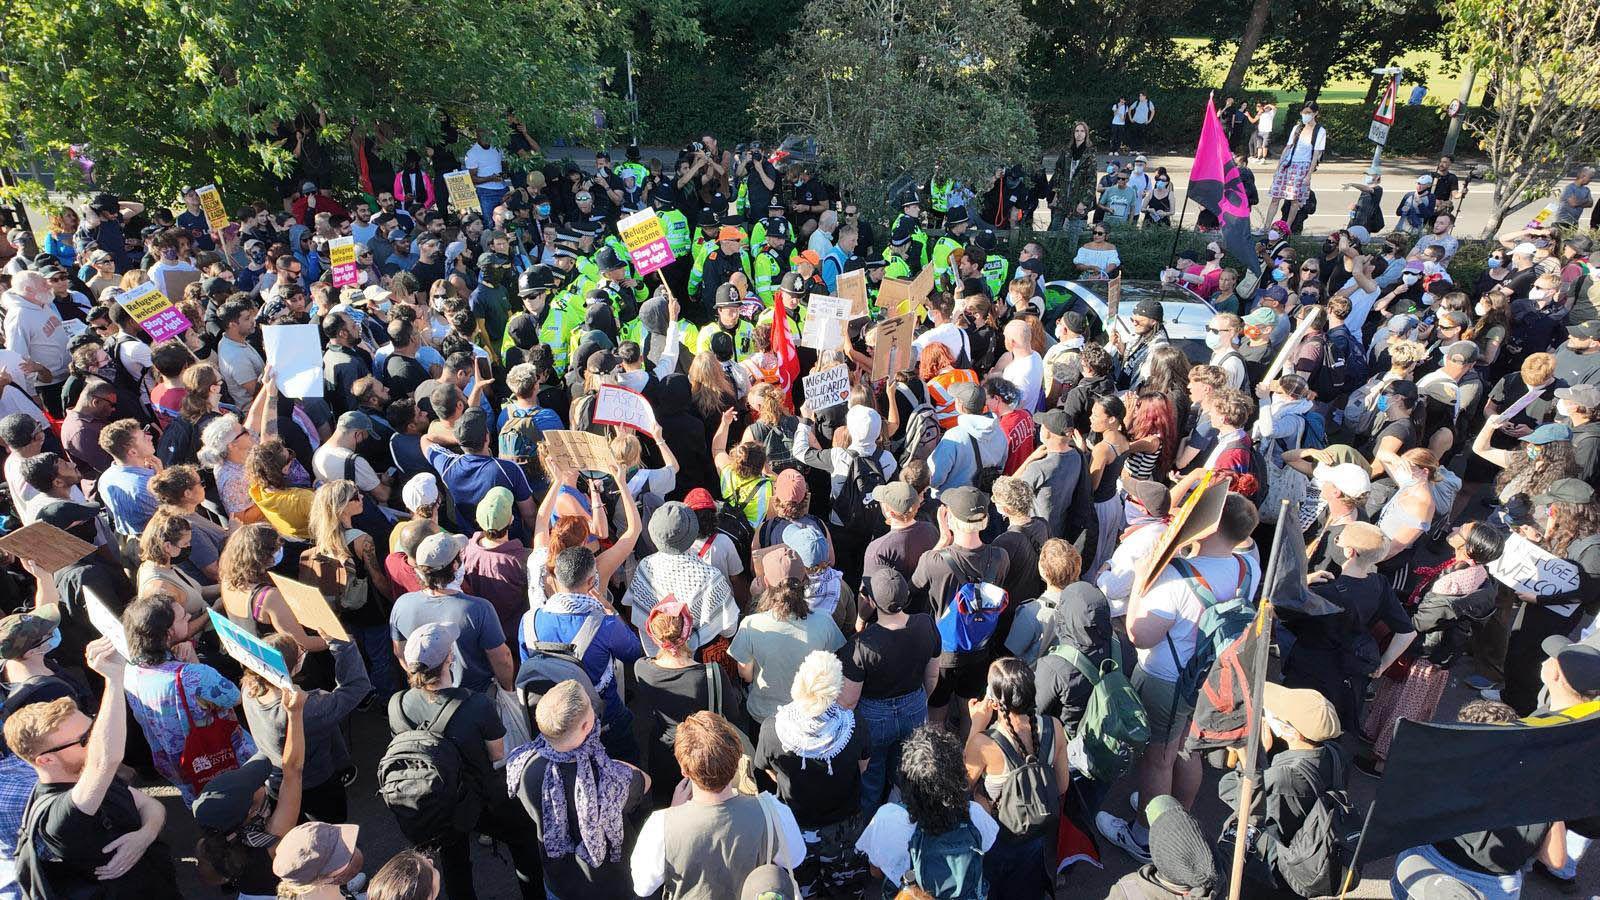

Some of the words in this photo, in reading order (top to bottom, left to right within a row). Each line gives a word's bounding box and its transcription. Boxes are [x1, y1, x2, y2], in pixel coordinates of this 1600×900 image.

[623, 220, 658, 240] Refugees
[628, 230, 661, 248] welcome
[632, 248, 652, 261] Stop
[650, 242, 665, 253] the
[637, 260, 649, 270] far
[649, 250, 669, 264] right
[333, 266, 345, 275] Stop
[984, 261, 1002, 269] POLICE
[125, 291, 162, 312] Refugees
[134, 299, 168, 319] welcome
[142, 317, 163, 330] Stop
[160, 310, 177, 321] the
[150, 327, 164, 338] far
[163, 316, 184, 331] right
[805, 376, 849, 400] SOLIDARITY
